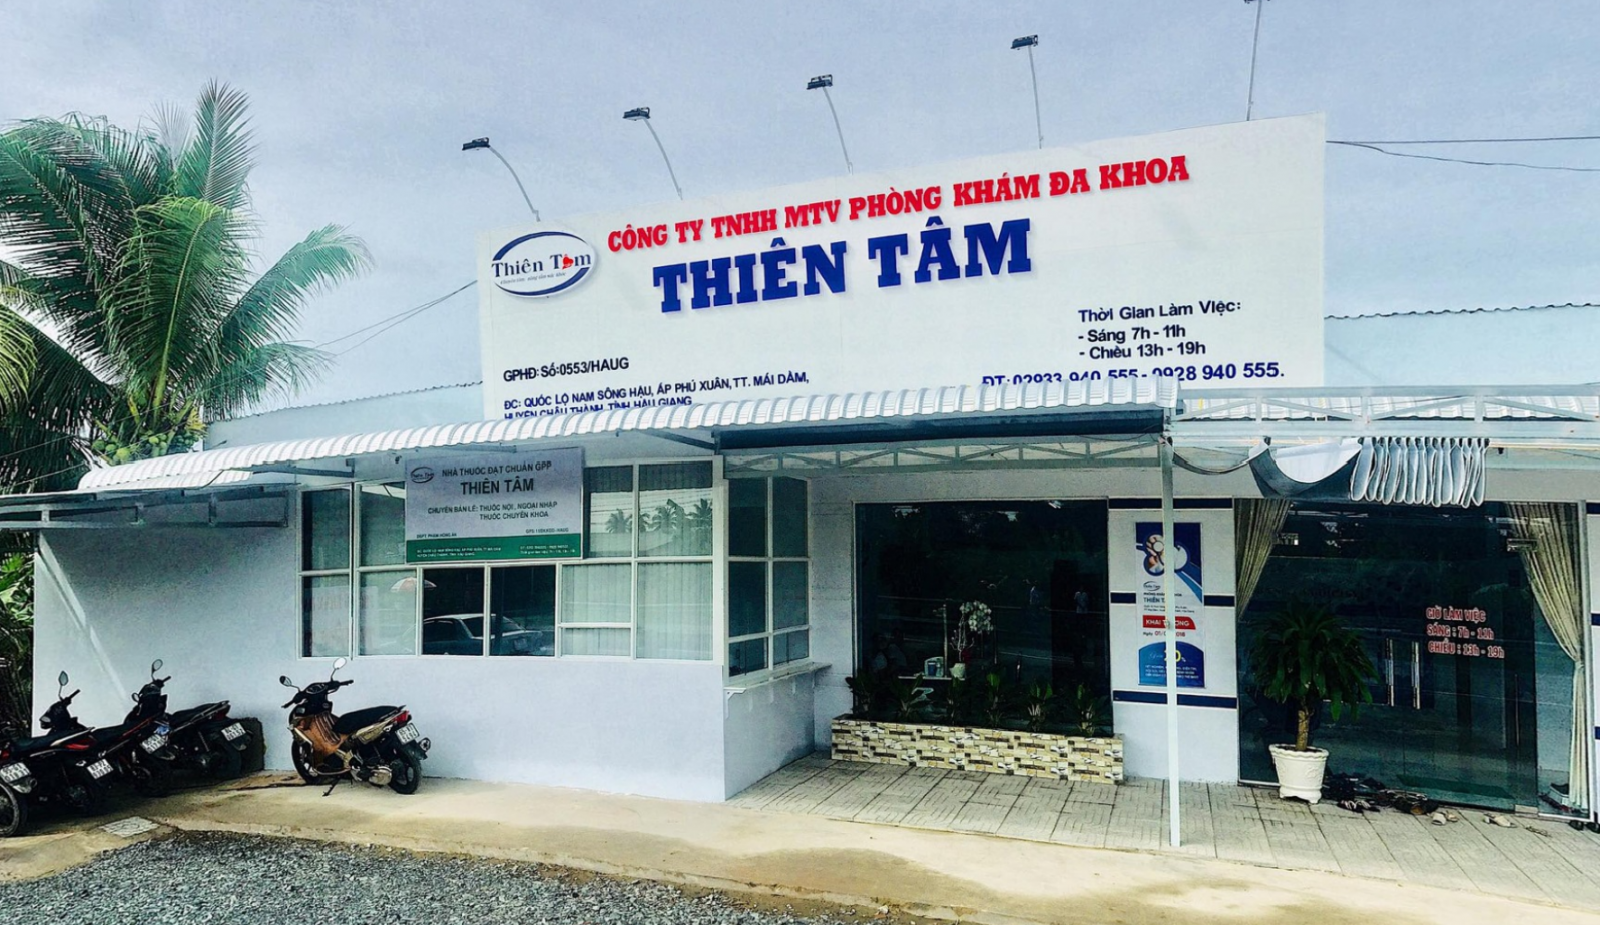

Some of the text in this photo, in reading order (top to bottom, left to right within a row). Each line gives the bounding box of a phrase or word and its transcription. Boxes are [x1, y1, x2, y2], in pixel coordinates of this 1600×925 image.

[608, 155, 1190, 252] CÔNG TY TNHH MTV PHÒNG KHÁM ĐA KHOA
[491, 258, 543, 277] Thiên
[653, 215, 1032, 313] THIÊN TÂM
[1078, 307, 1114, 323] Thời
[1119, 306, 1155, 320] Gian
[1159, 303, 1193, 317] Làm
[1087, 329, 1126, 344] Sáng
[1132, 327, 1151, 340] 7h
[1163, 324, 1186, 338] 11h
[1137, 343, 1164, 358] 13h
[1177, 341, 1206, 355] 19h
[1202, 362, 1237, 380] 940
[1243, 361, 1285, 379] 555.
[504, 399, 521, 410] ĐC:
[555, 393, 570, 406] LỘ
[572, 391, 595, 403] NAM
[597, 387, 627, 401] SÔNG
[629, 385, 654, 399] HẬU,
[675, 380, 696, 394] PHÚ
[699, 377, 732, 391] XUÂN,
[733, 377, 751, 388] TT.
[753, 372, 775, 387] MÁI
[442, 467, 458, 477] NHÀ
[488, 465, 504, 476] ĐẠT
[461, 475, 534, 495] THIÊN TÂM
[530, 510, 549, 518] KHOA
[1425, 604, 1486, 624] GIỜ LÀM VIỆC
[1427, 622, 1451, 637] SÁNG
[1457, 626, 1470, 639] 7h
[1463, 643, 1480, 656] 13h
[1487, 645, 1505, 659] 19h
